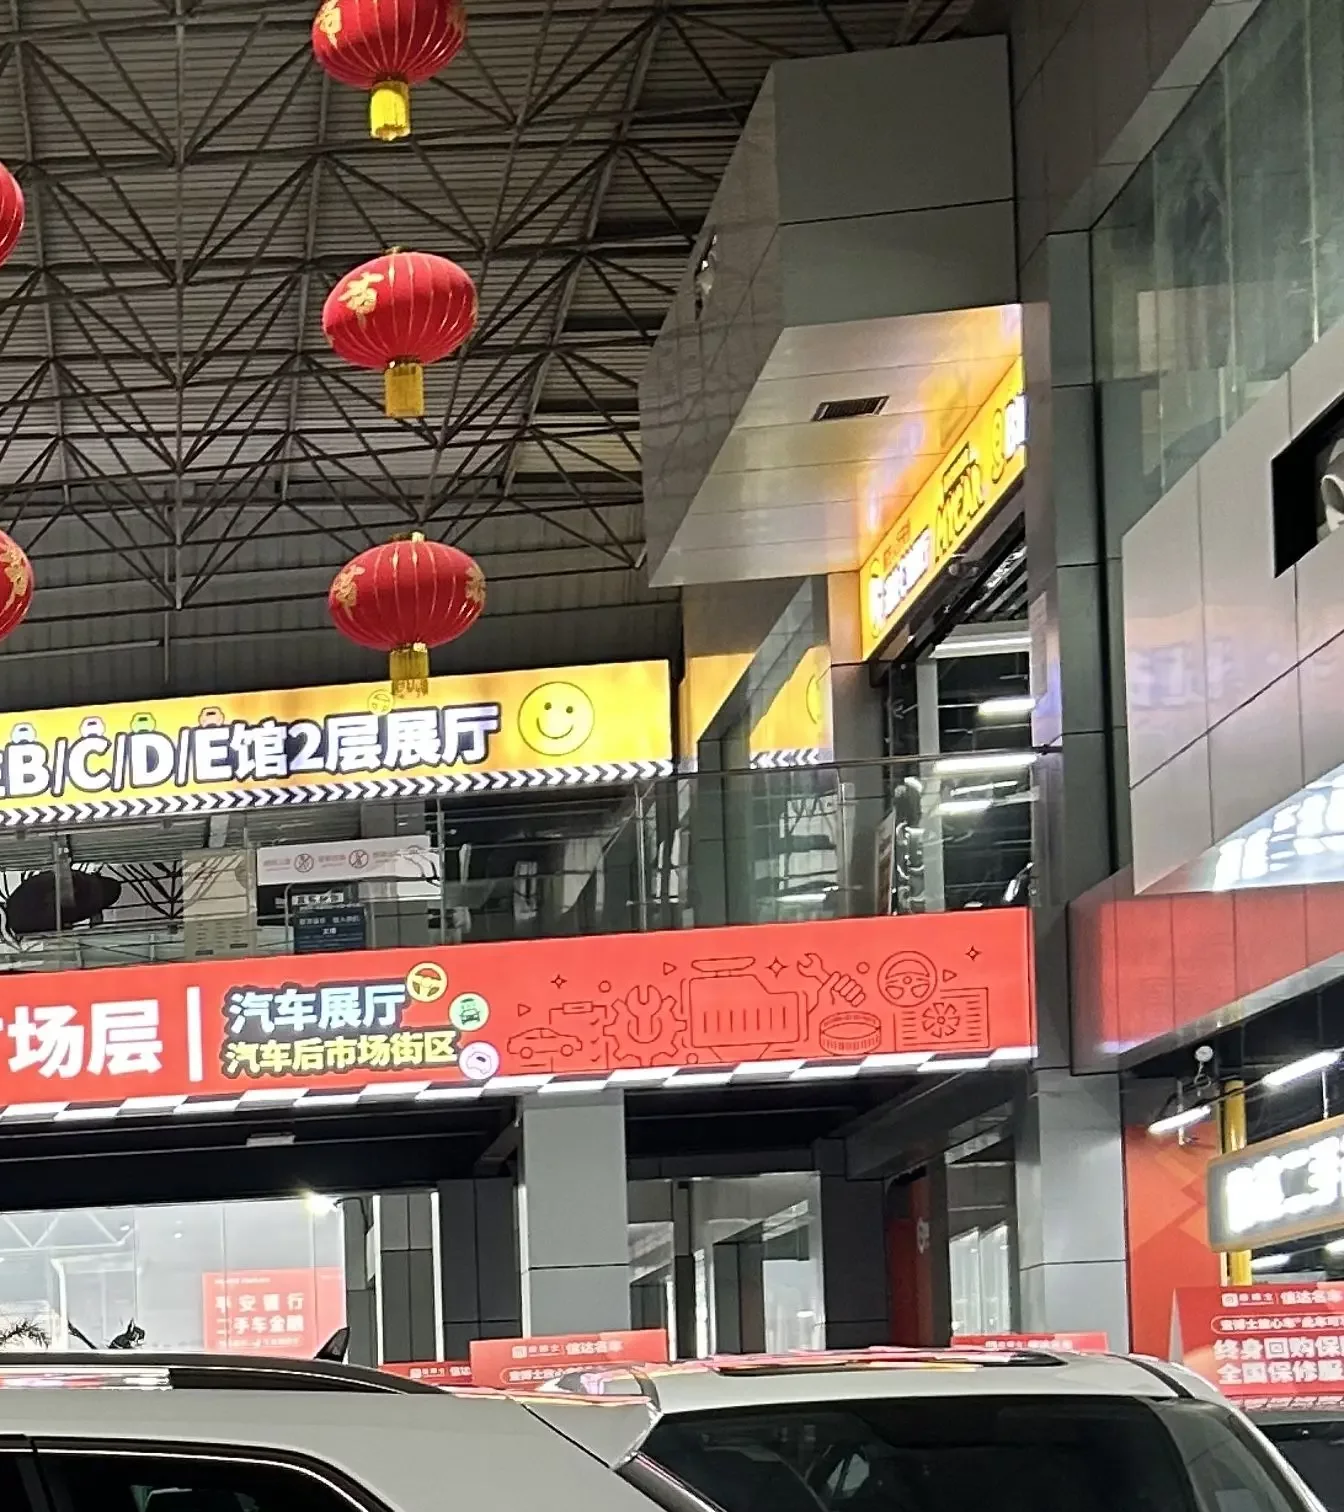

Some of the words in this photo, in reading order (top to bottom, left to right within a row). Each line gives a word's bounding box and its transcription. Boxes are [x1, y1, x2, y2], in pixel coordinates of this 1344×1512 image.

[226, 982, 408, 1035] 汽车展厅
[224, 1026, 462, 1076] 汽车后市场街区
[1213, 1335, 1344, 1361] 终身回购保
